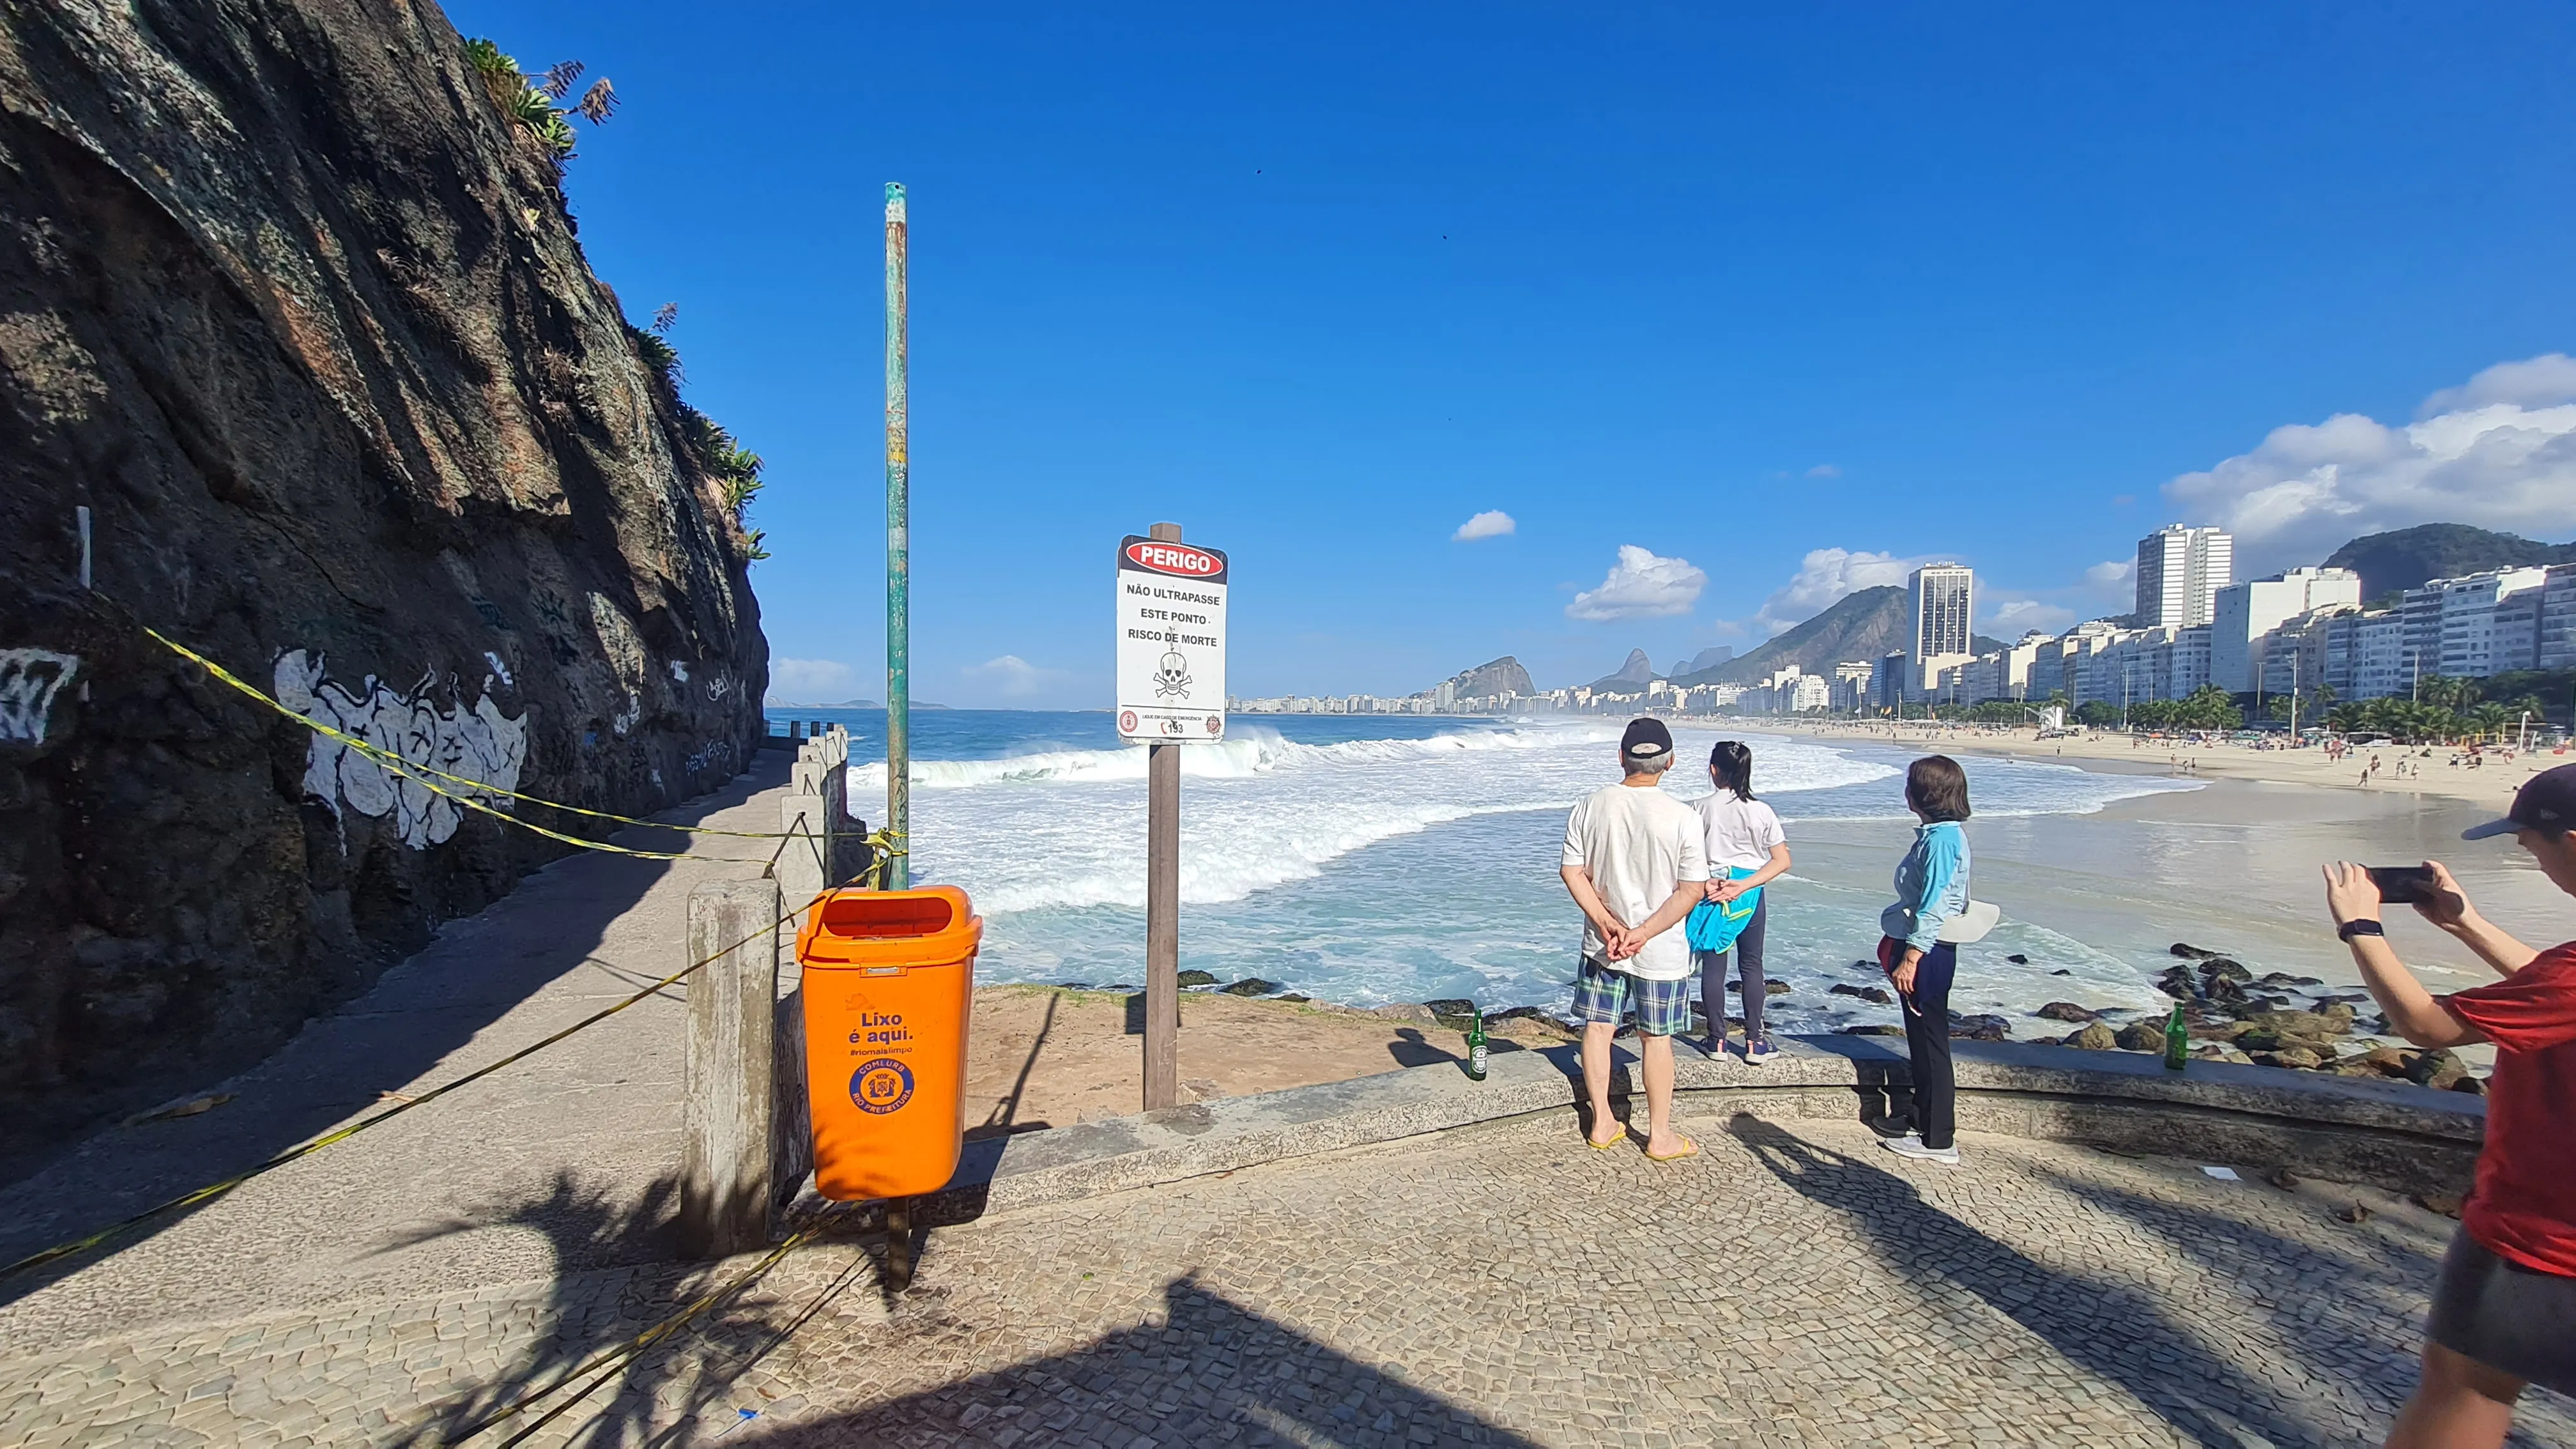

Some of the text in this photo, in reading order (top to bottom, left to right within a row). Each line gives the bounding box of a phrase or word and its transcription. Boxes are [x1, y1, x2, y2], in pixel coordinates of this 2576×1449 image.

[1140, 546, 1211, 572] PERIGO
[1126, 583, 1220, 606] NÃO ULTRAPASSE
[1141, 608, 1206, 625] ESTE PONTO
[1128, 629, 1217, 647] RISCO DE MORTE
[1168, 724, 1183, 733] 193
[862, 1012, 903, 1027] Lixo
[848, 1026, 914, 1045] é aqui.
[850, 1046, 913, 1056] #riomaislimpo
[859, 1060, 905, 1075] COMLURB
[852, 1089, 912, 1114] RIO PREFEITURA
